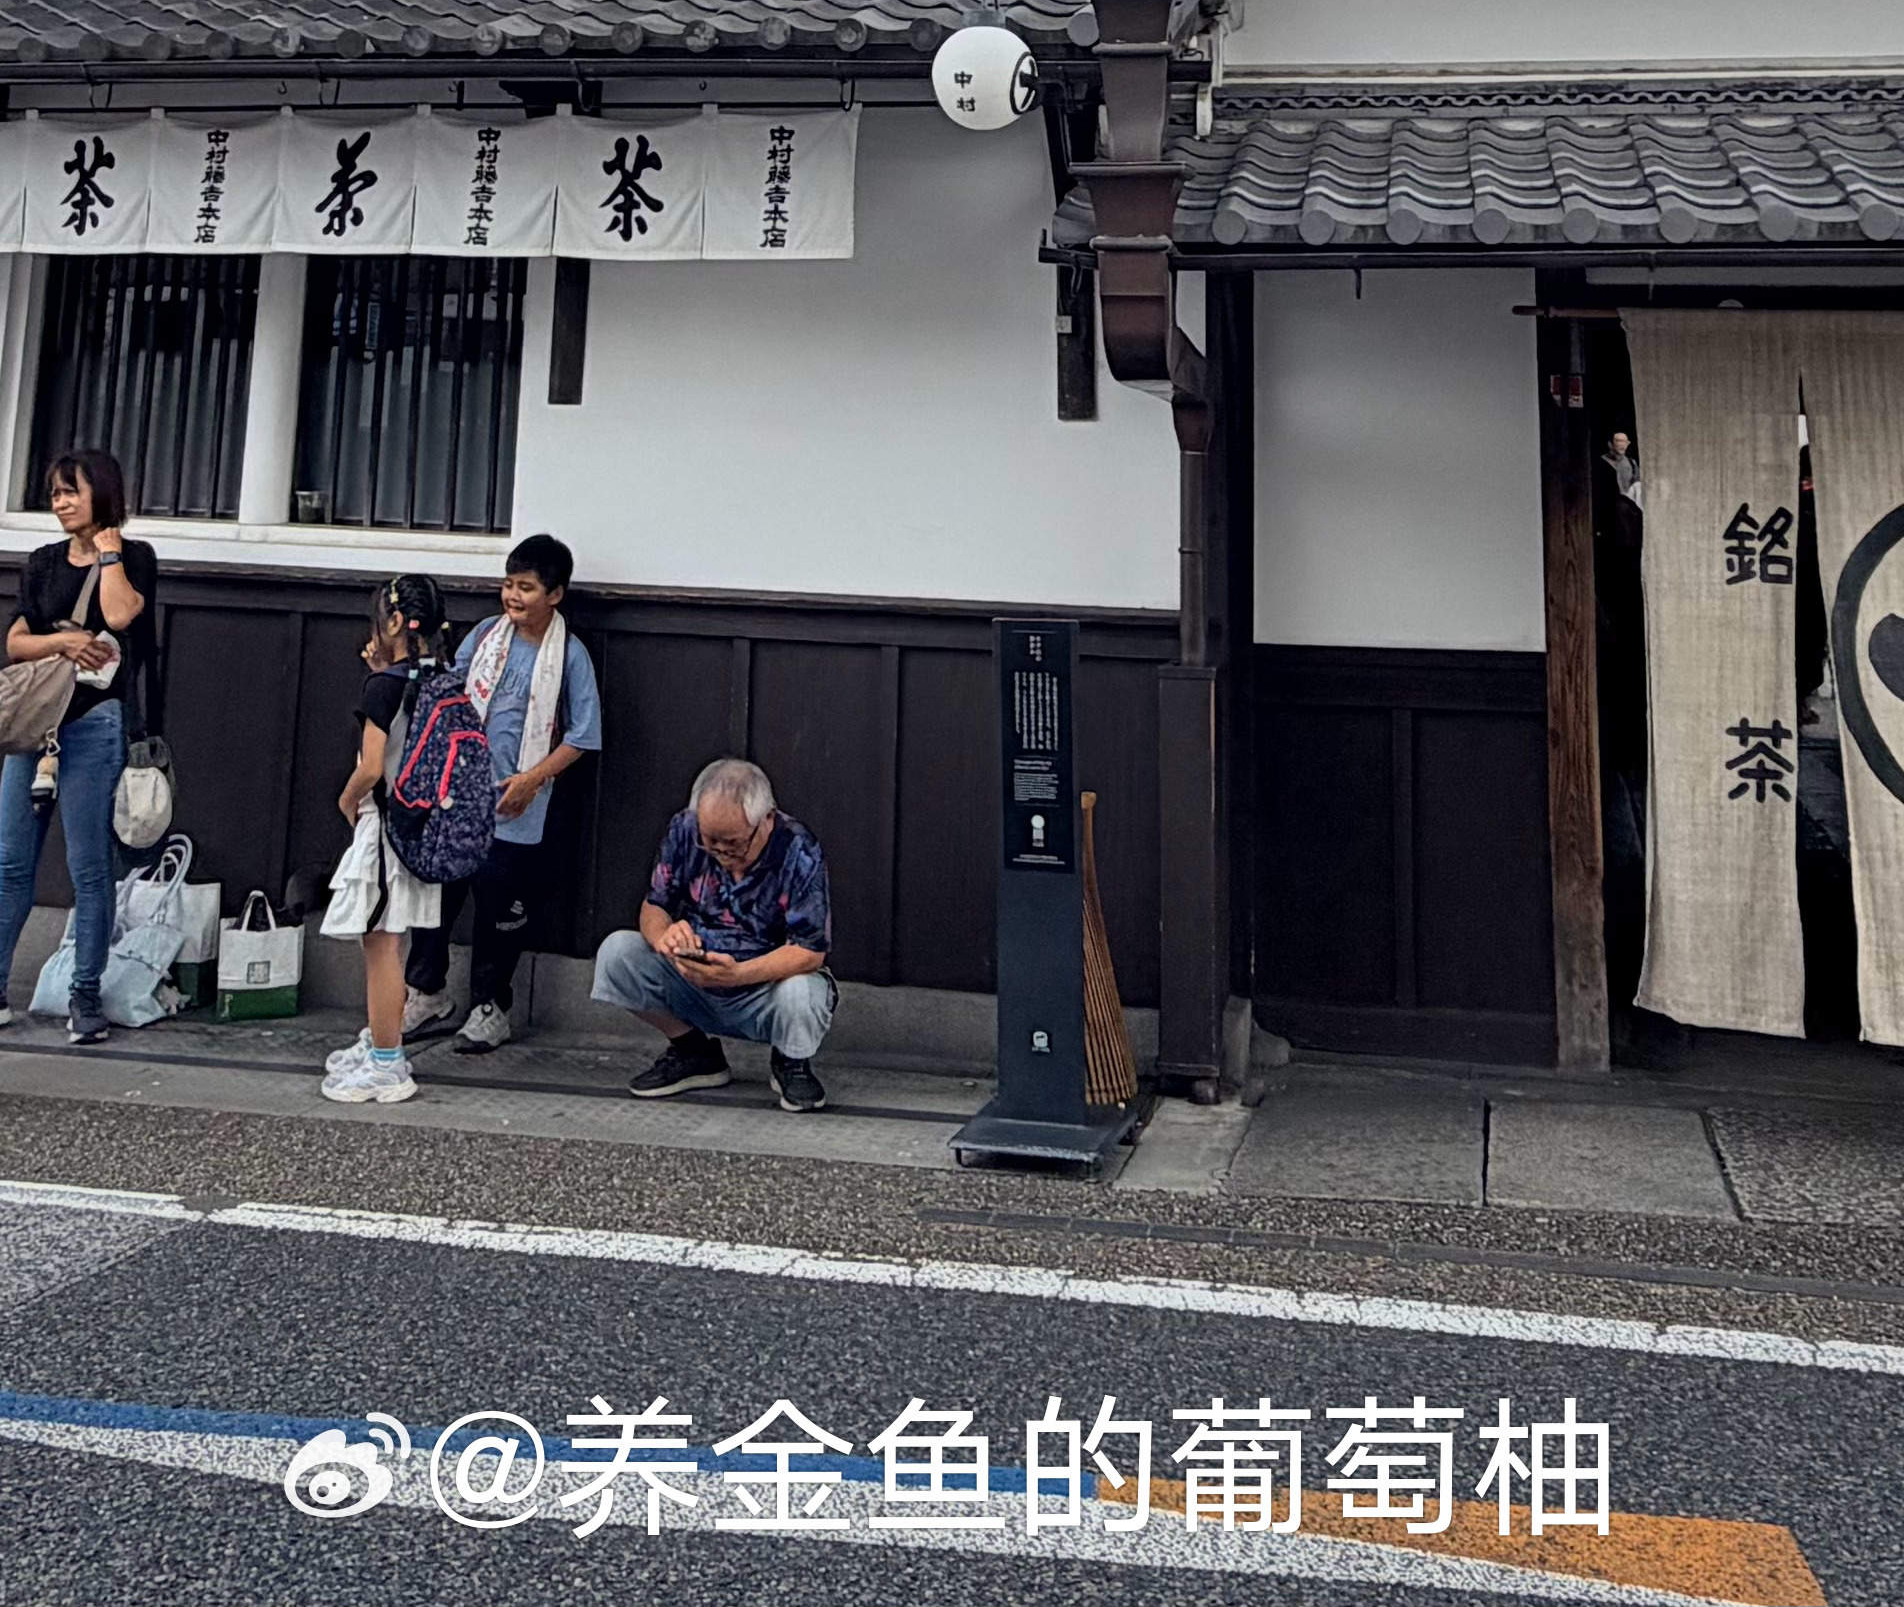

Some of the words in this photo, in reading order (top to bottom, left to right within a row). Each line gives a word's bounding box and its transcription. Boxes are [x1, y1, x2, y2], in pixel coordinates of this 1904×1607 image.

[954, 71, 976, 112] 中村
[61, 136, 115, 236] 茶
[315, 131, 378, 236] 茶
[600, 135, 664, 241] 茶
